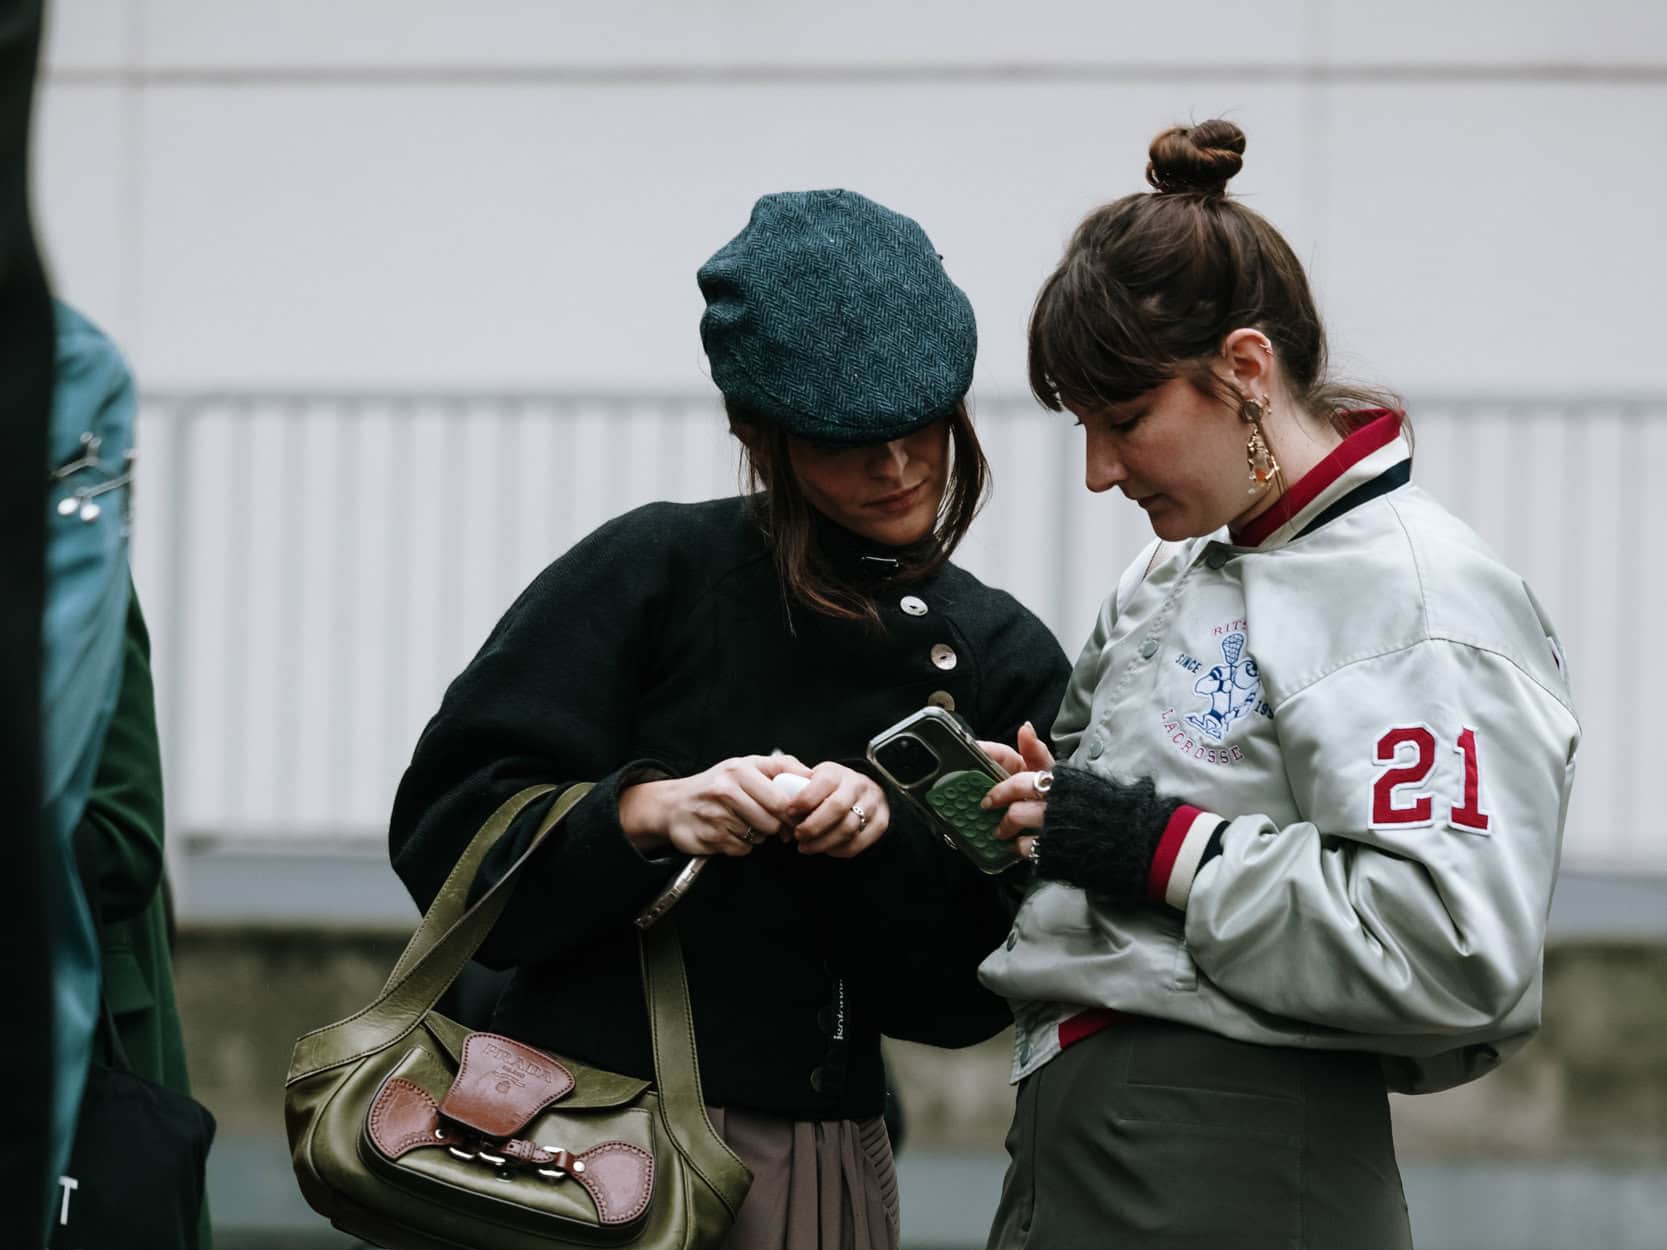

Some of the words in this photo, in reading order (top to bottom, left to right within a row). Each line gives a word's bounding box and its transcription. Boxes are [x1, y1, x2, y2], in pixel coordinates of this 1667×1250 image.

[1175, 653, 1202, 674] SINCE
[1161, 708, 1244, 763] LACROSSE
[1368, 724, 1490, 836] 21
[483, 1043, 553, 1083] PRADA
